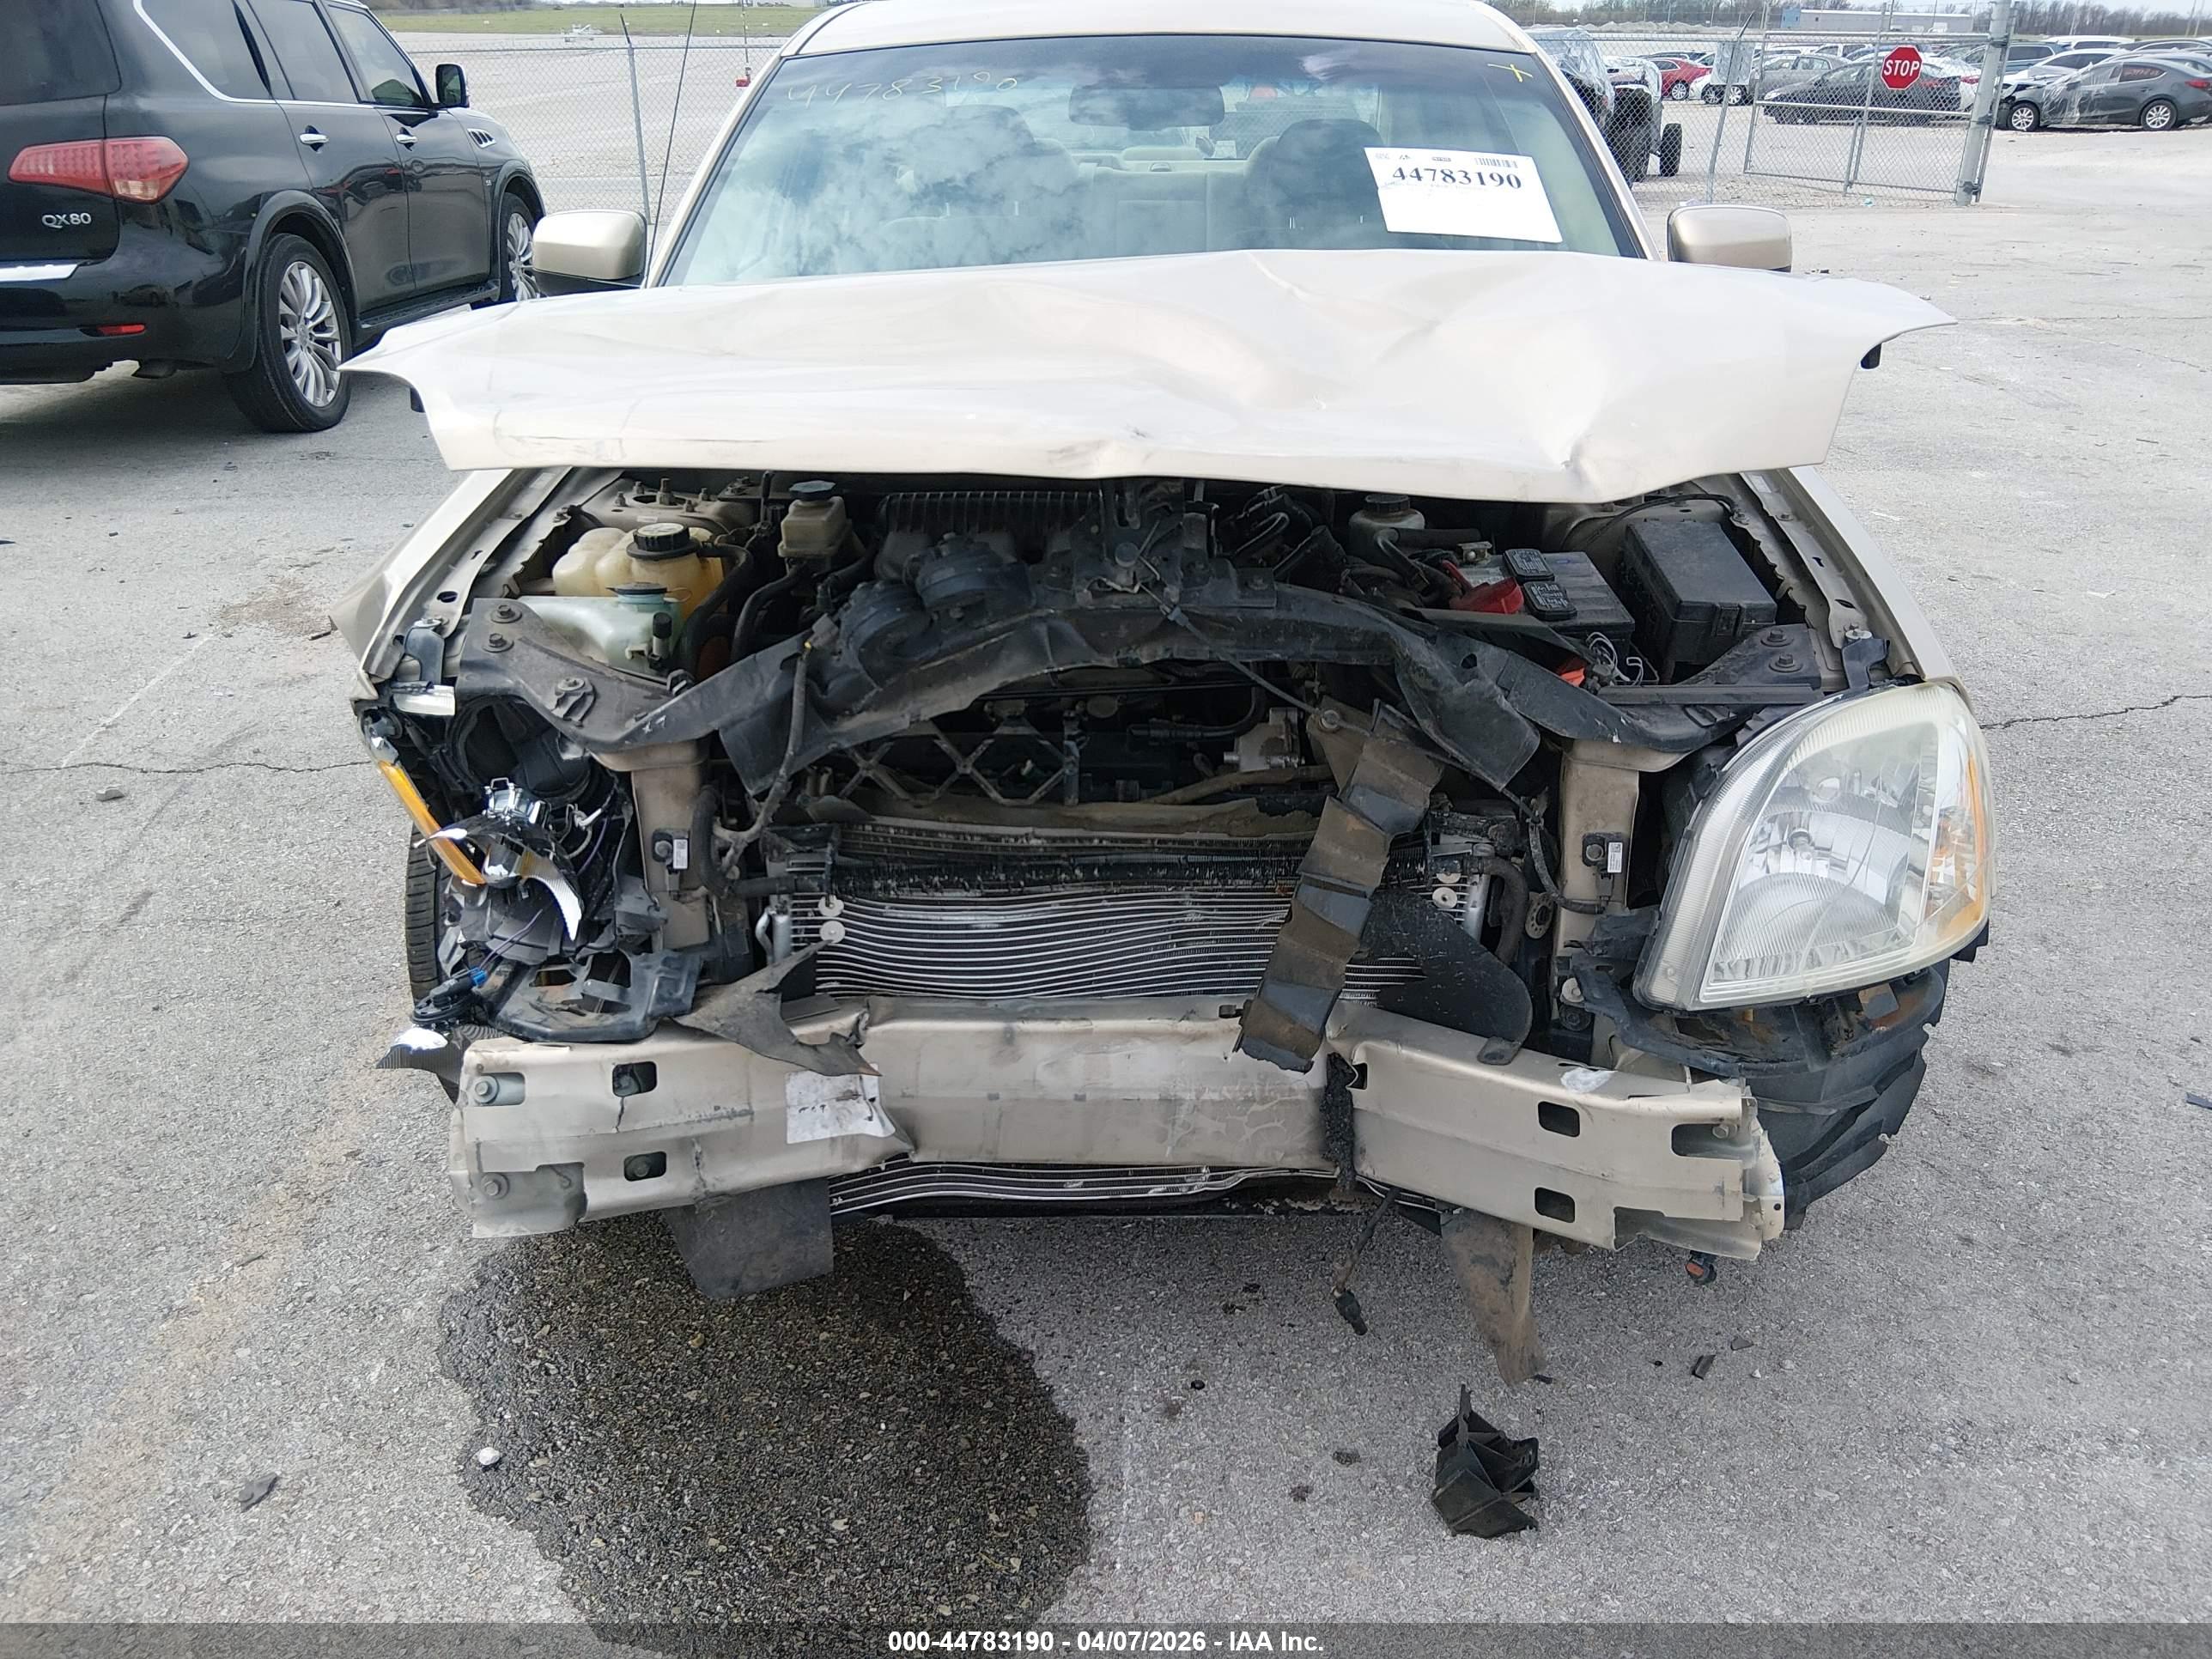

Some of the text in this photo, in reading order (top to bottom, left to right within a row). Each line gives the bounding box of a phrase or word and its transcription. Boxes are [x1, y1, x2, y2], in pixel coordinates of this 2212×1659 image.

[1883, 59, 1920, 76] STOP
[1392, 167, 1522, 189] 44783190
[41, 212, 92, 228] QX80
